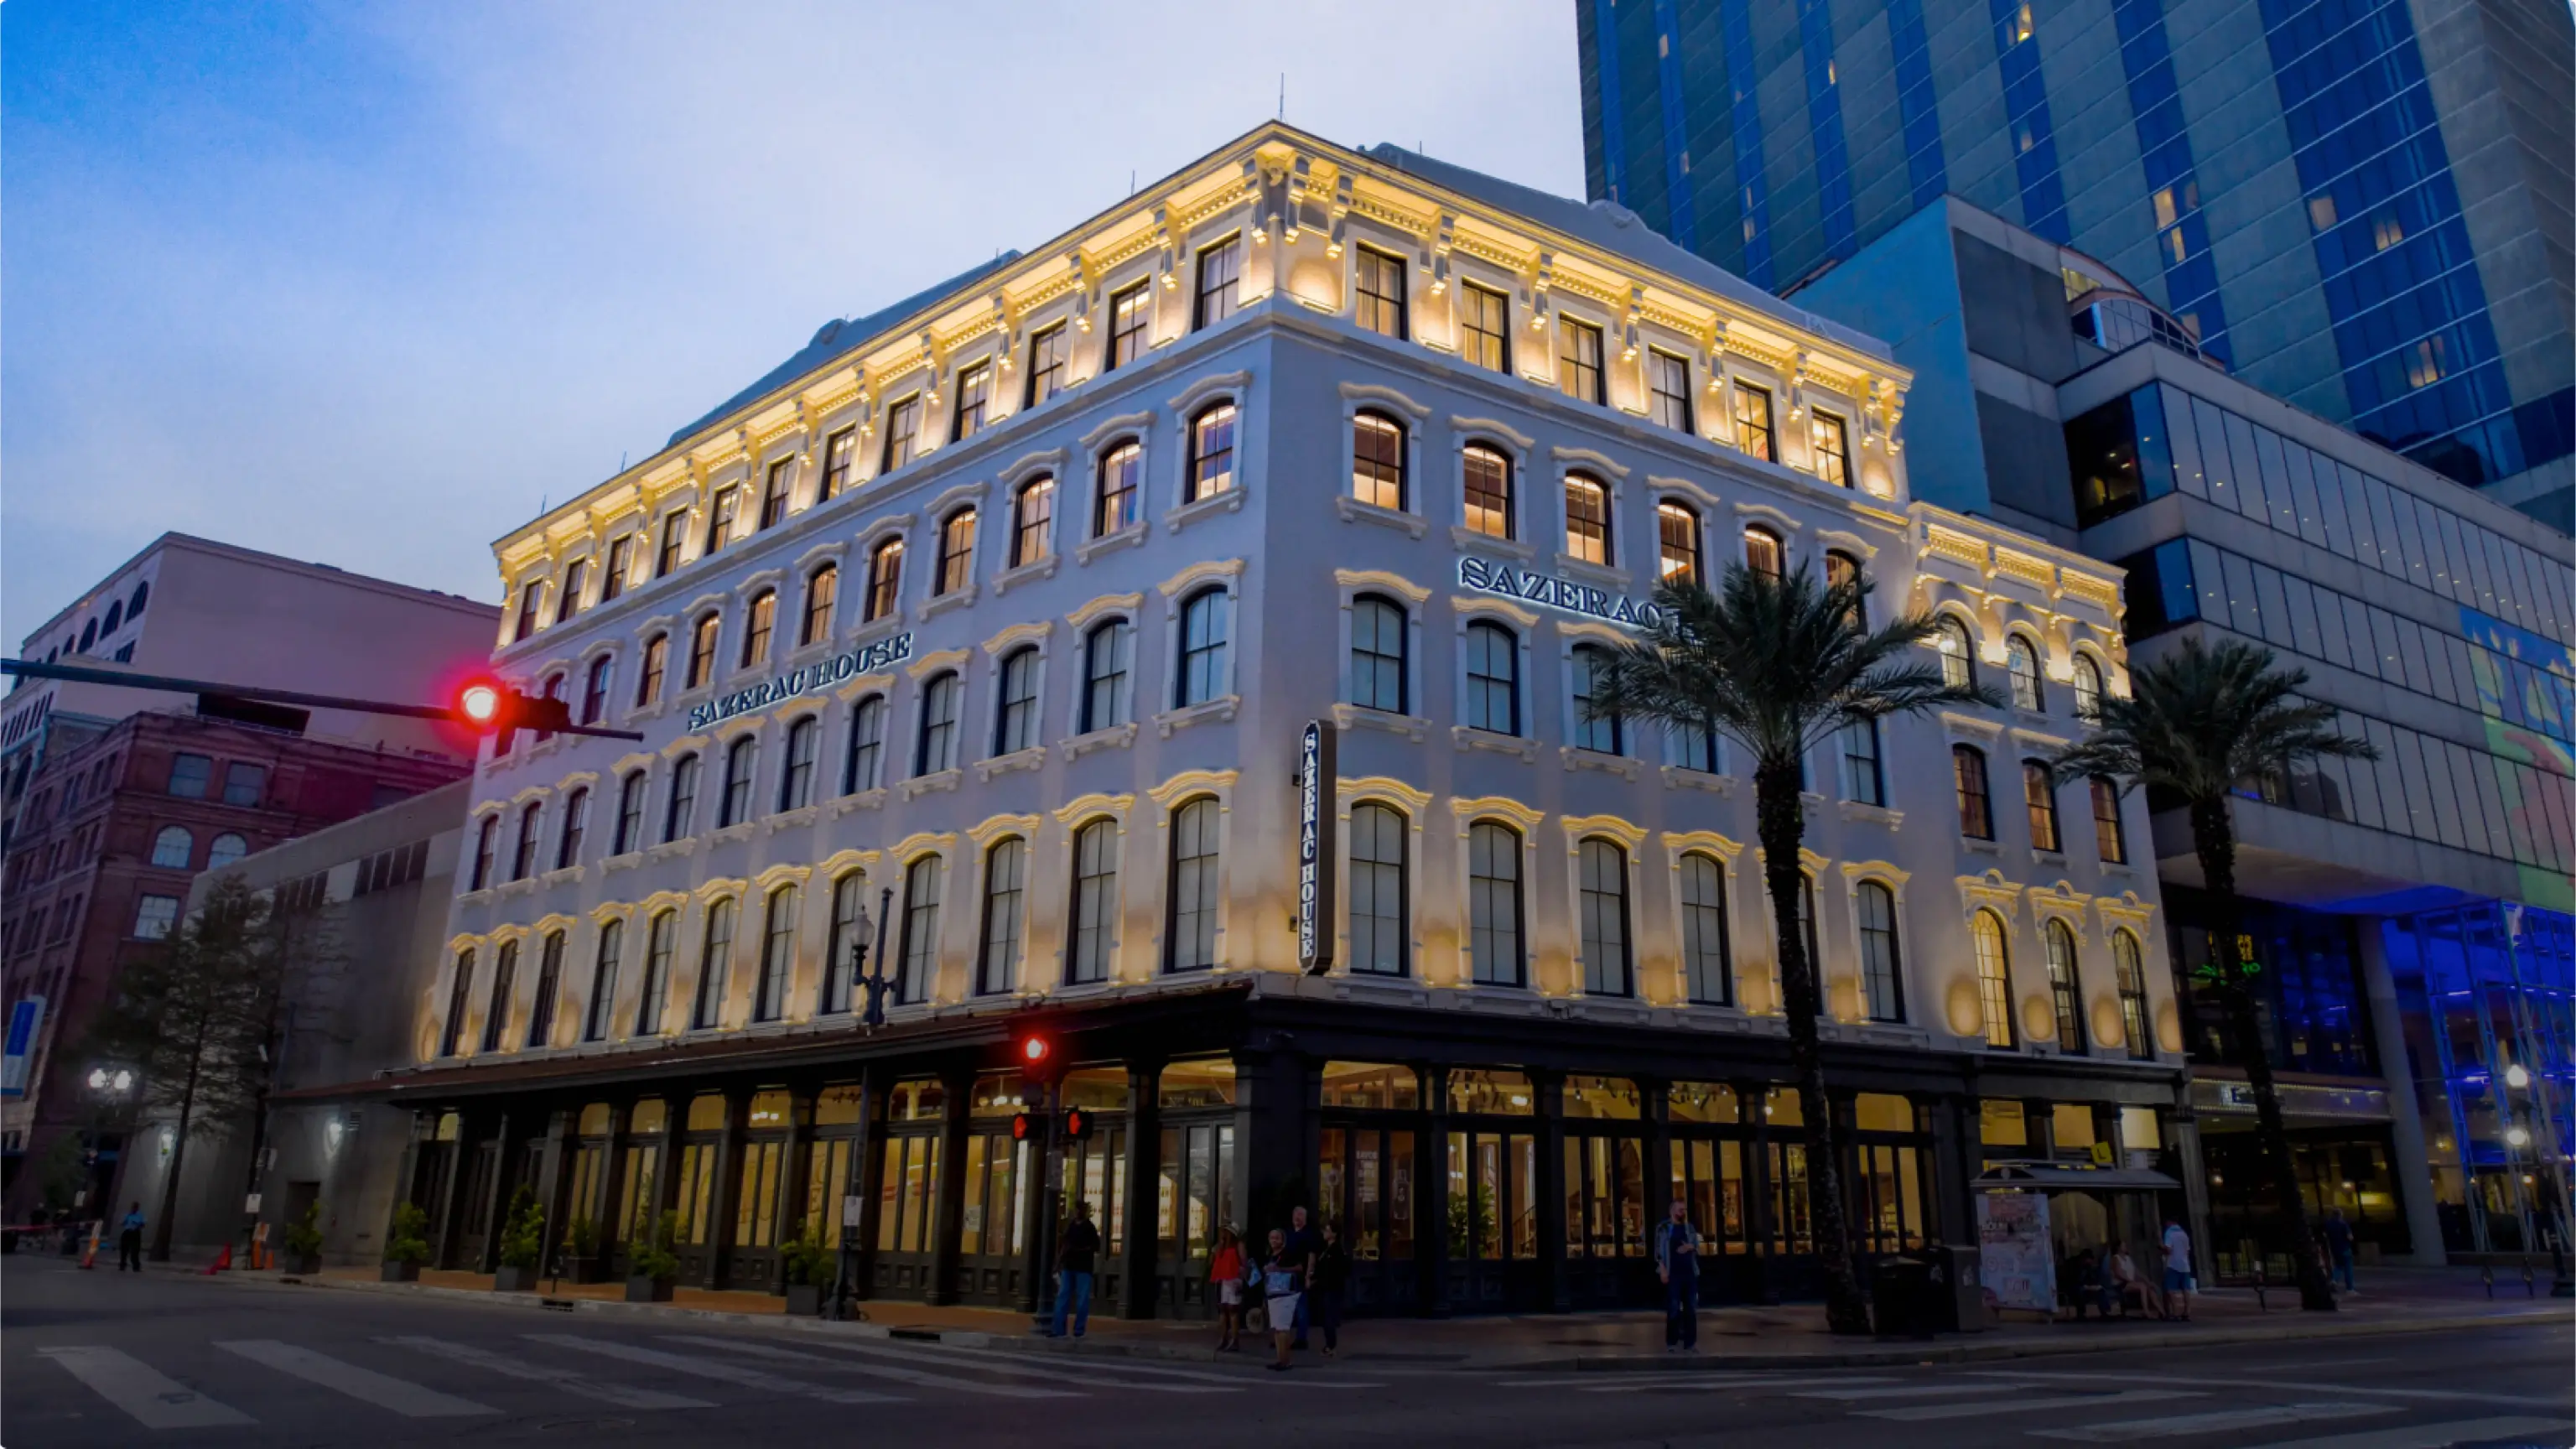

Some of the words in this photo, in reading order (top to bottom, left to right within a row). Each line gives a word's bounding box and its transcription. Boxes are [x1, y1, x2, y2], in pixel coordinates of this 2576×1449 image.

[688, 669, 806, 731] SAZERAC
[810, 631, 912, 690] HOUSE
[1303, 733, 1316, 860] SAZERAC
[1301, 864, 1315, 958] HOUSE
